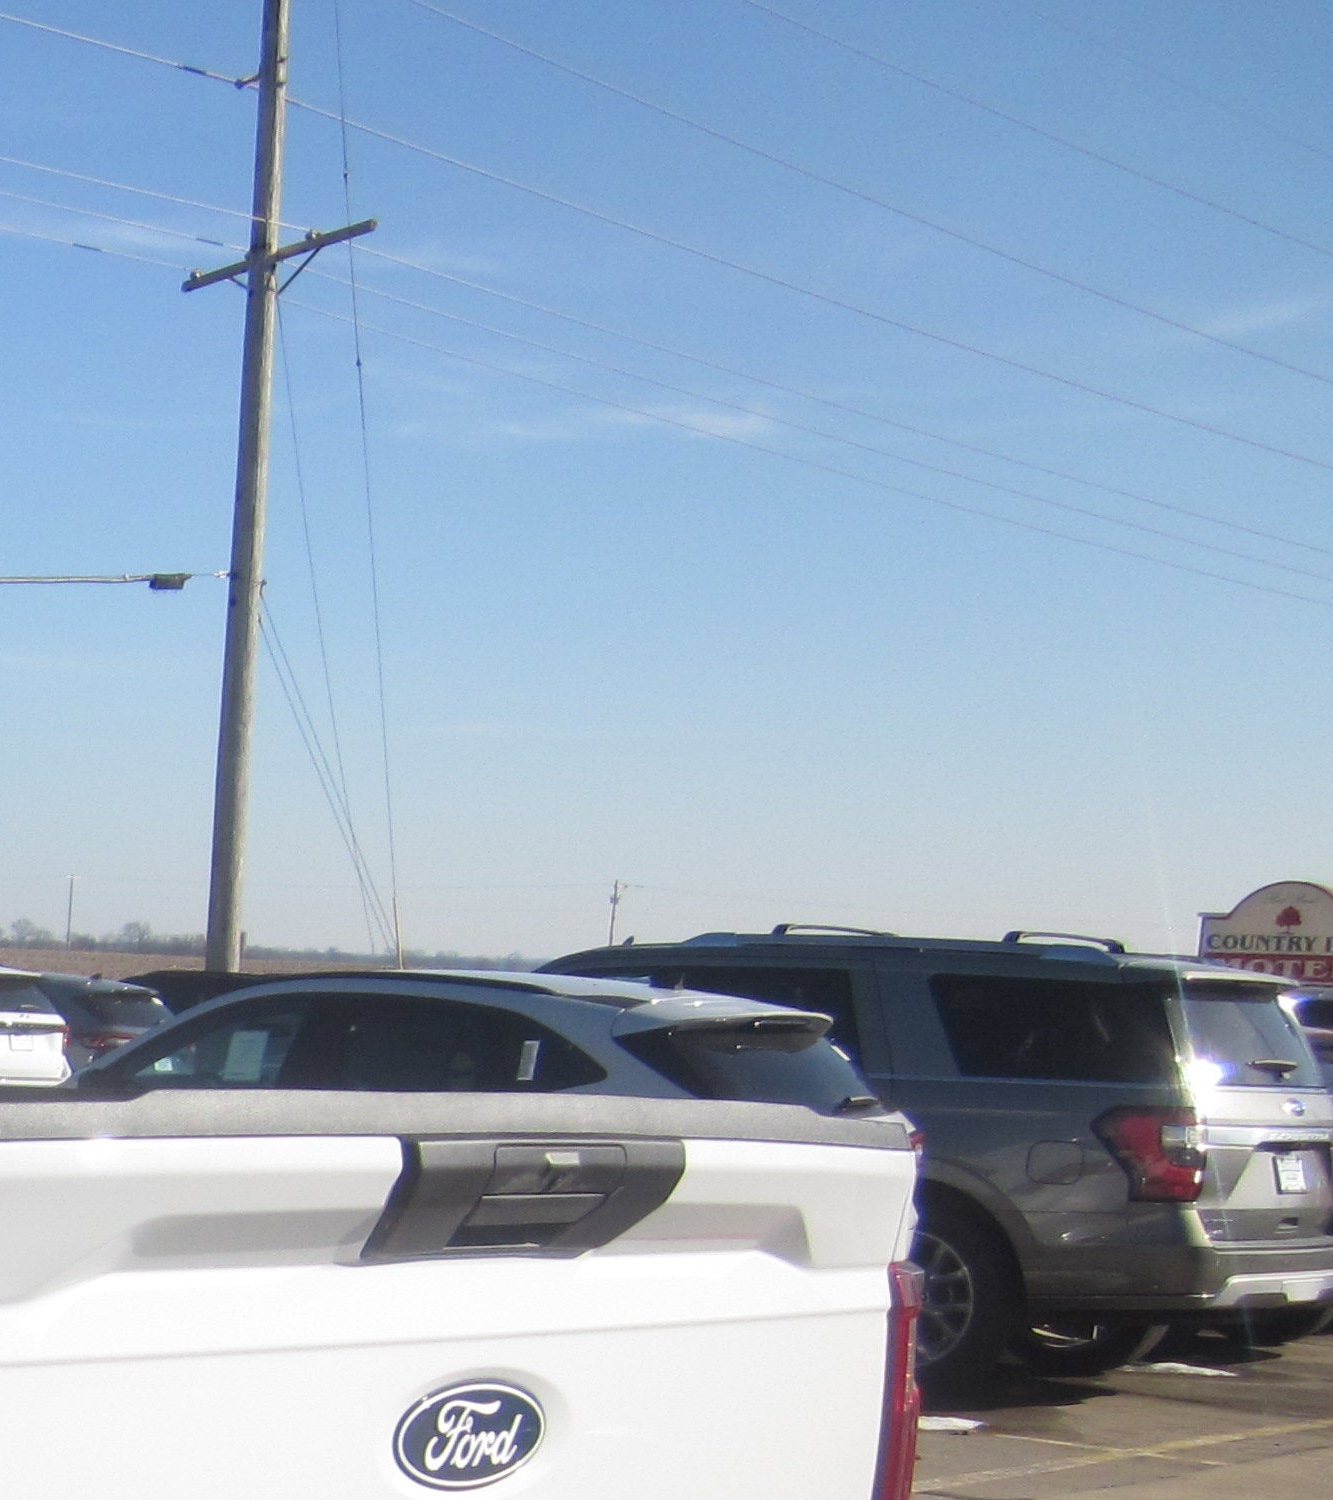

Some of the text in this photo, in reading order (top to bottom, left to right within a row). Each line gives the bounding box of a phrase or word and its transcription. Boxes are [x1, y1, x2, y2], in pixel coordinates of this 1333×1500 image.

[1207, 934, 1318, 952] COUNTRY
[1226, 957, 1333, 979] OTE
[424, 1397, 519, 1472] Ford
